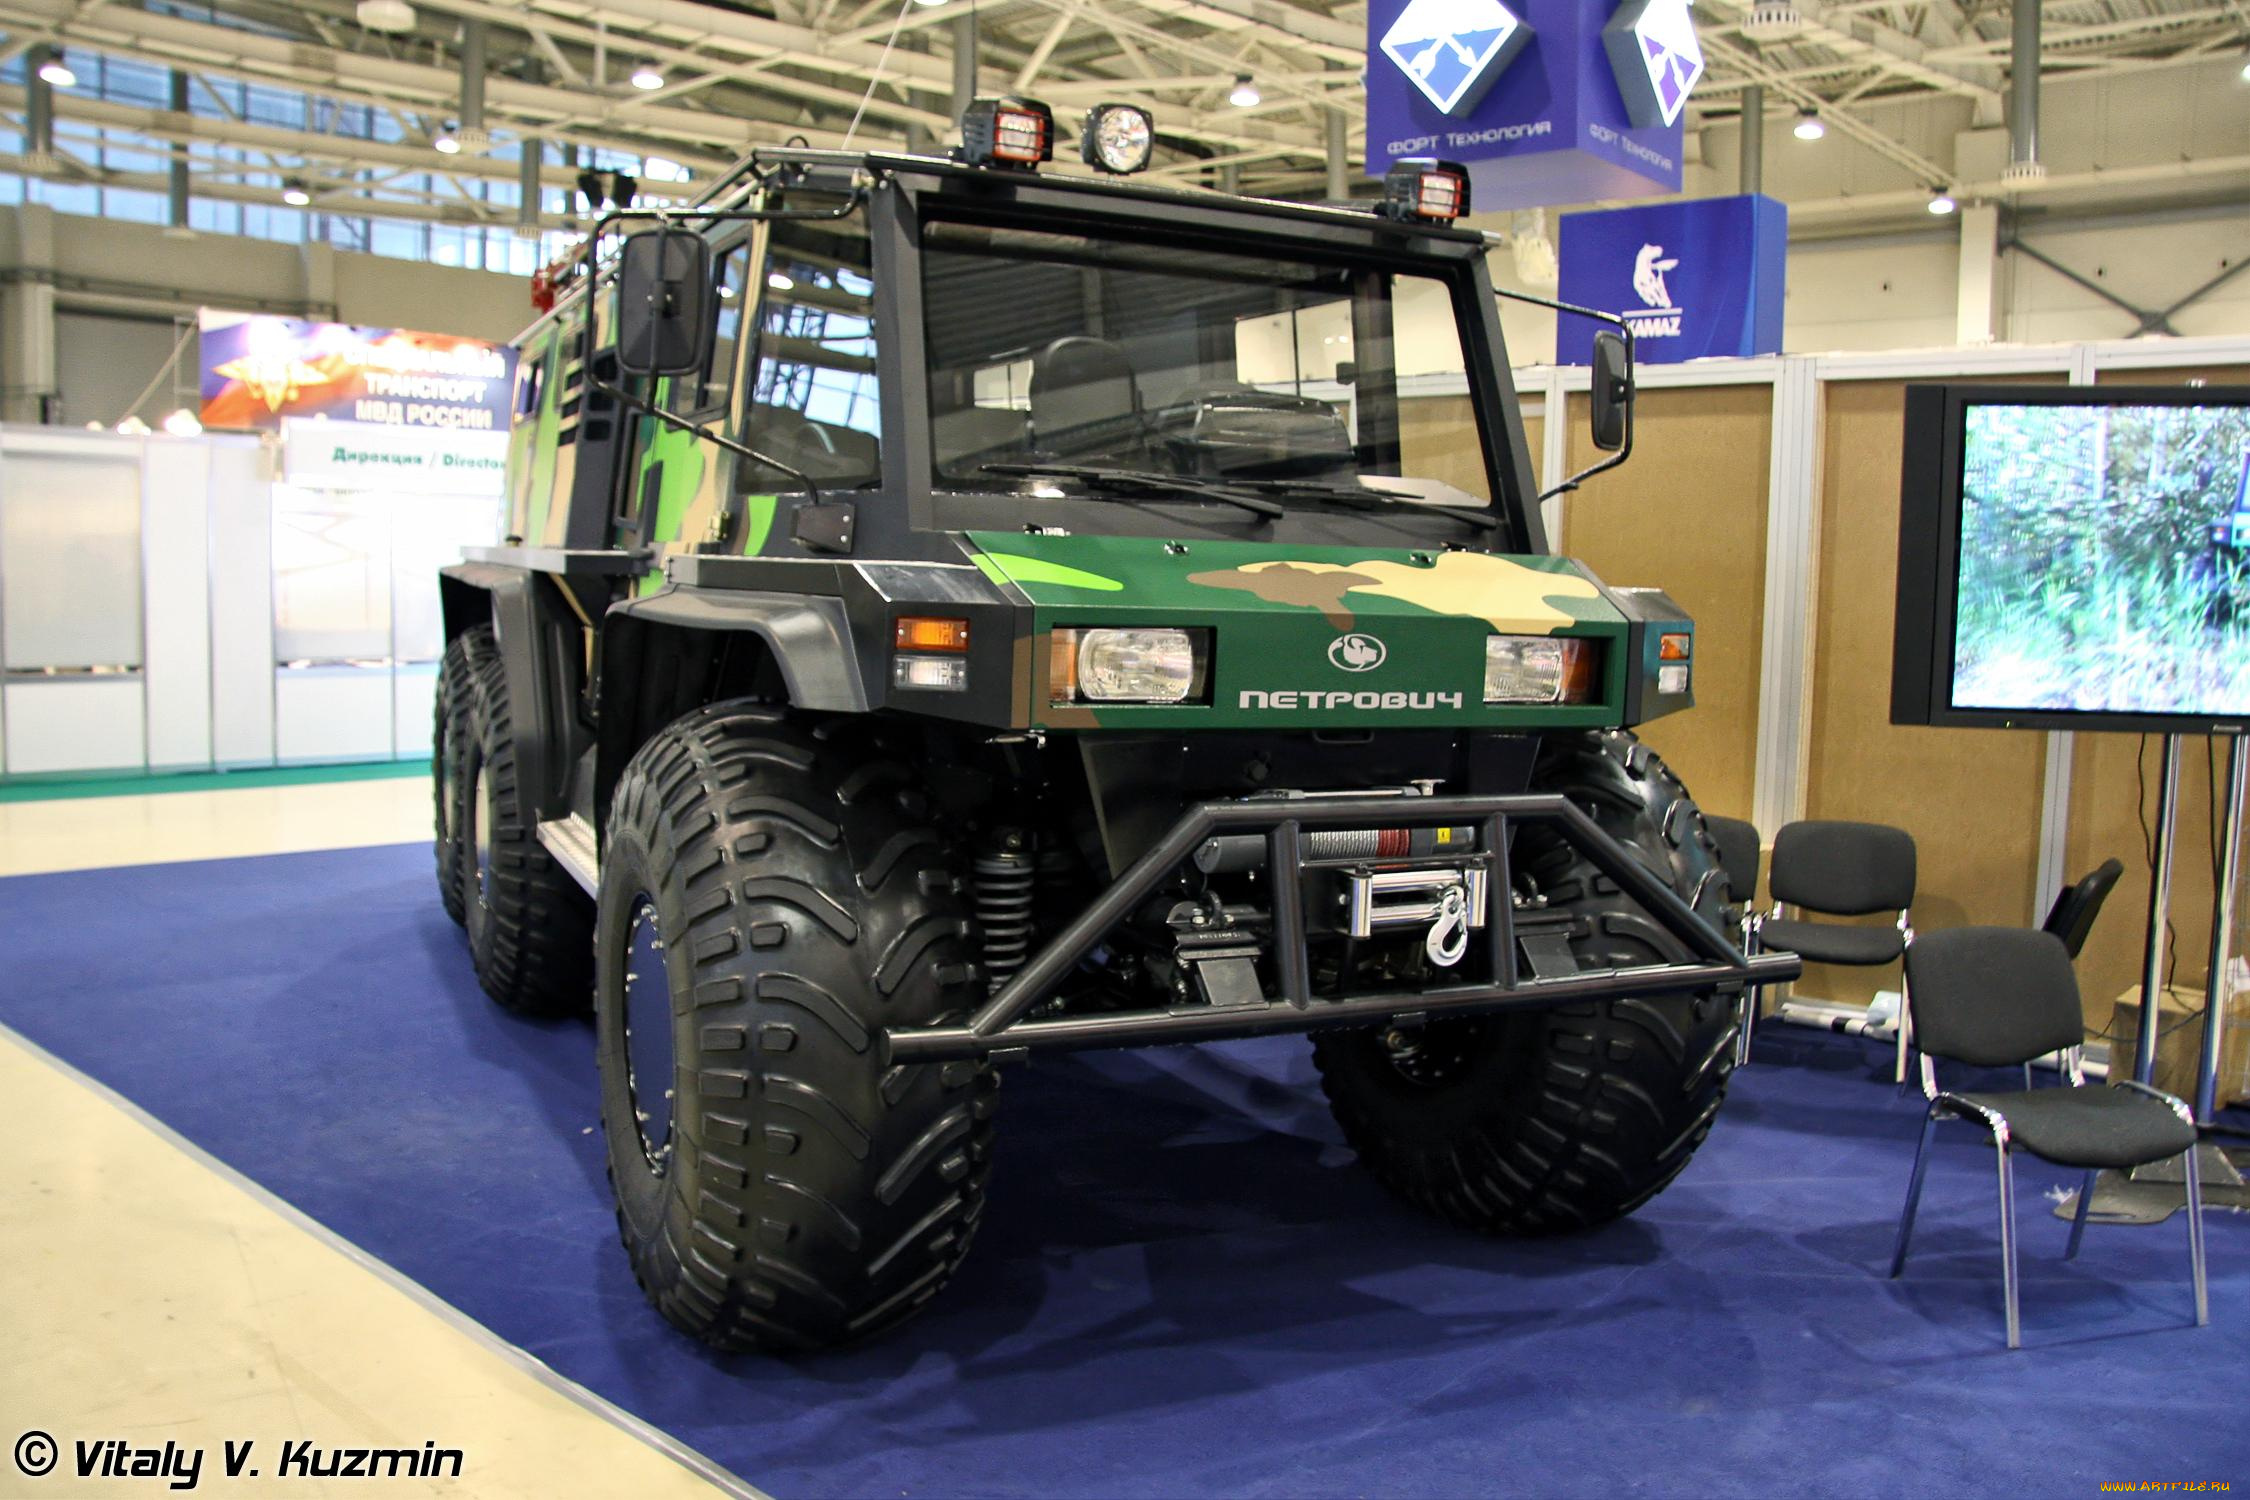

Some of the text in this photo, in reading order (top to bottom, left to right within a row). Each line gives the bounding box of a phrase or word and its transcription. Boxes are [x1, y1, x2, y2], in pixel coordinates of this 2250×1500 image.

[1387, 135, 1440, 155] ФОРТ
[364, 372, 487, 403] ТРАНСПОРТ
[356, 400, 492, 430] МВД РОССИИ
[332, 446, 423, 466] Дирекция
[1239, 690, 1463, 709] ПЕТРОВИЧ
